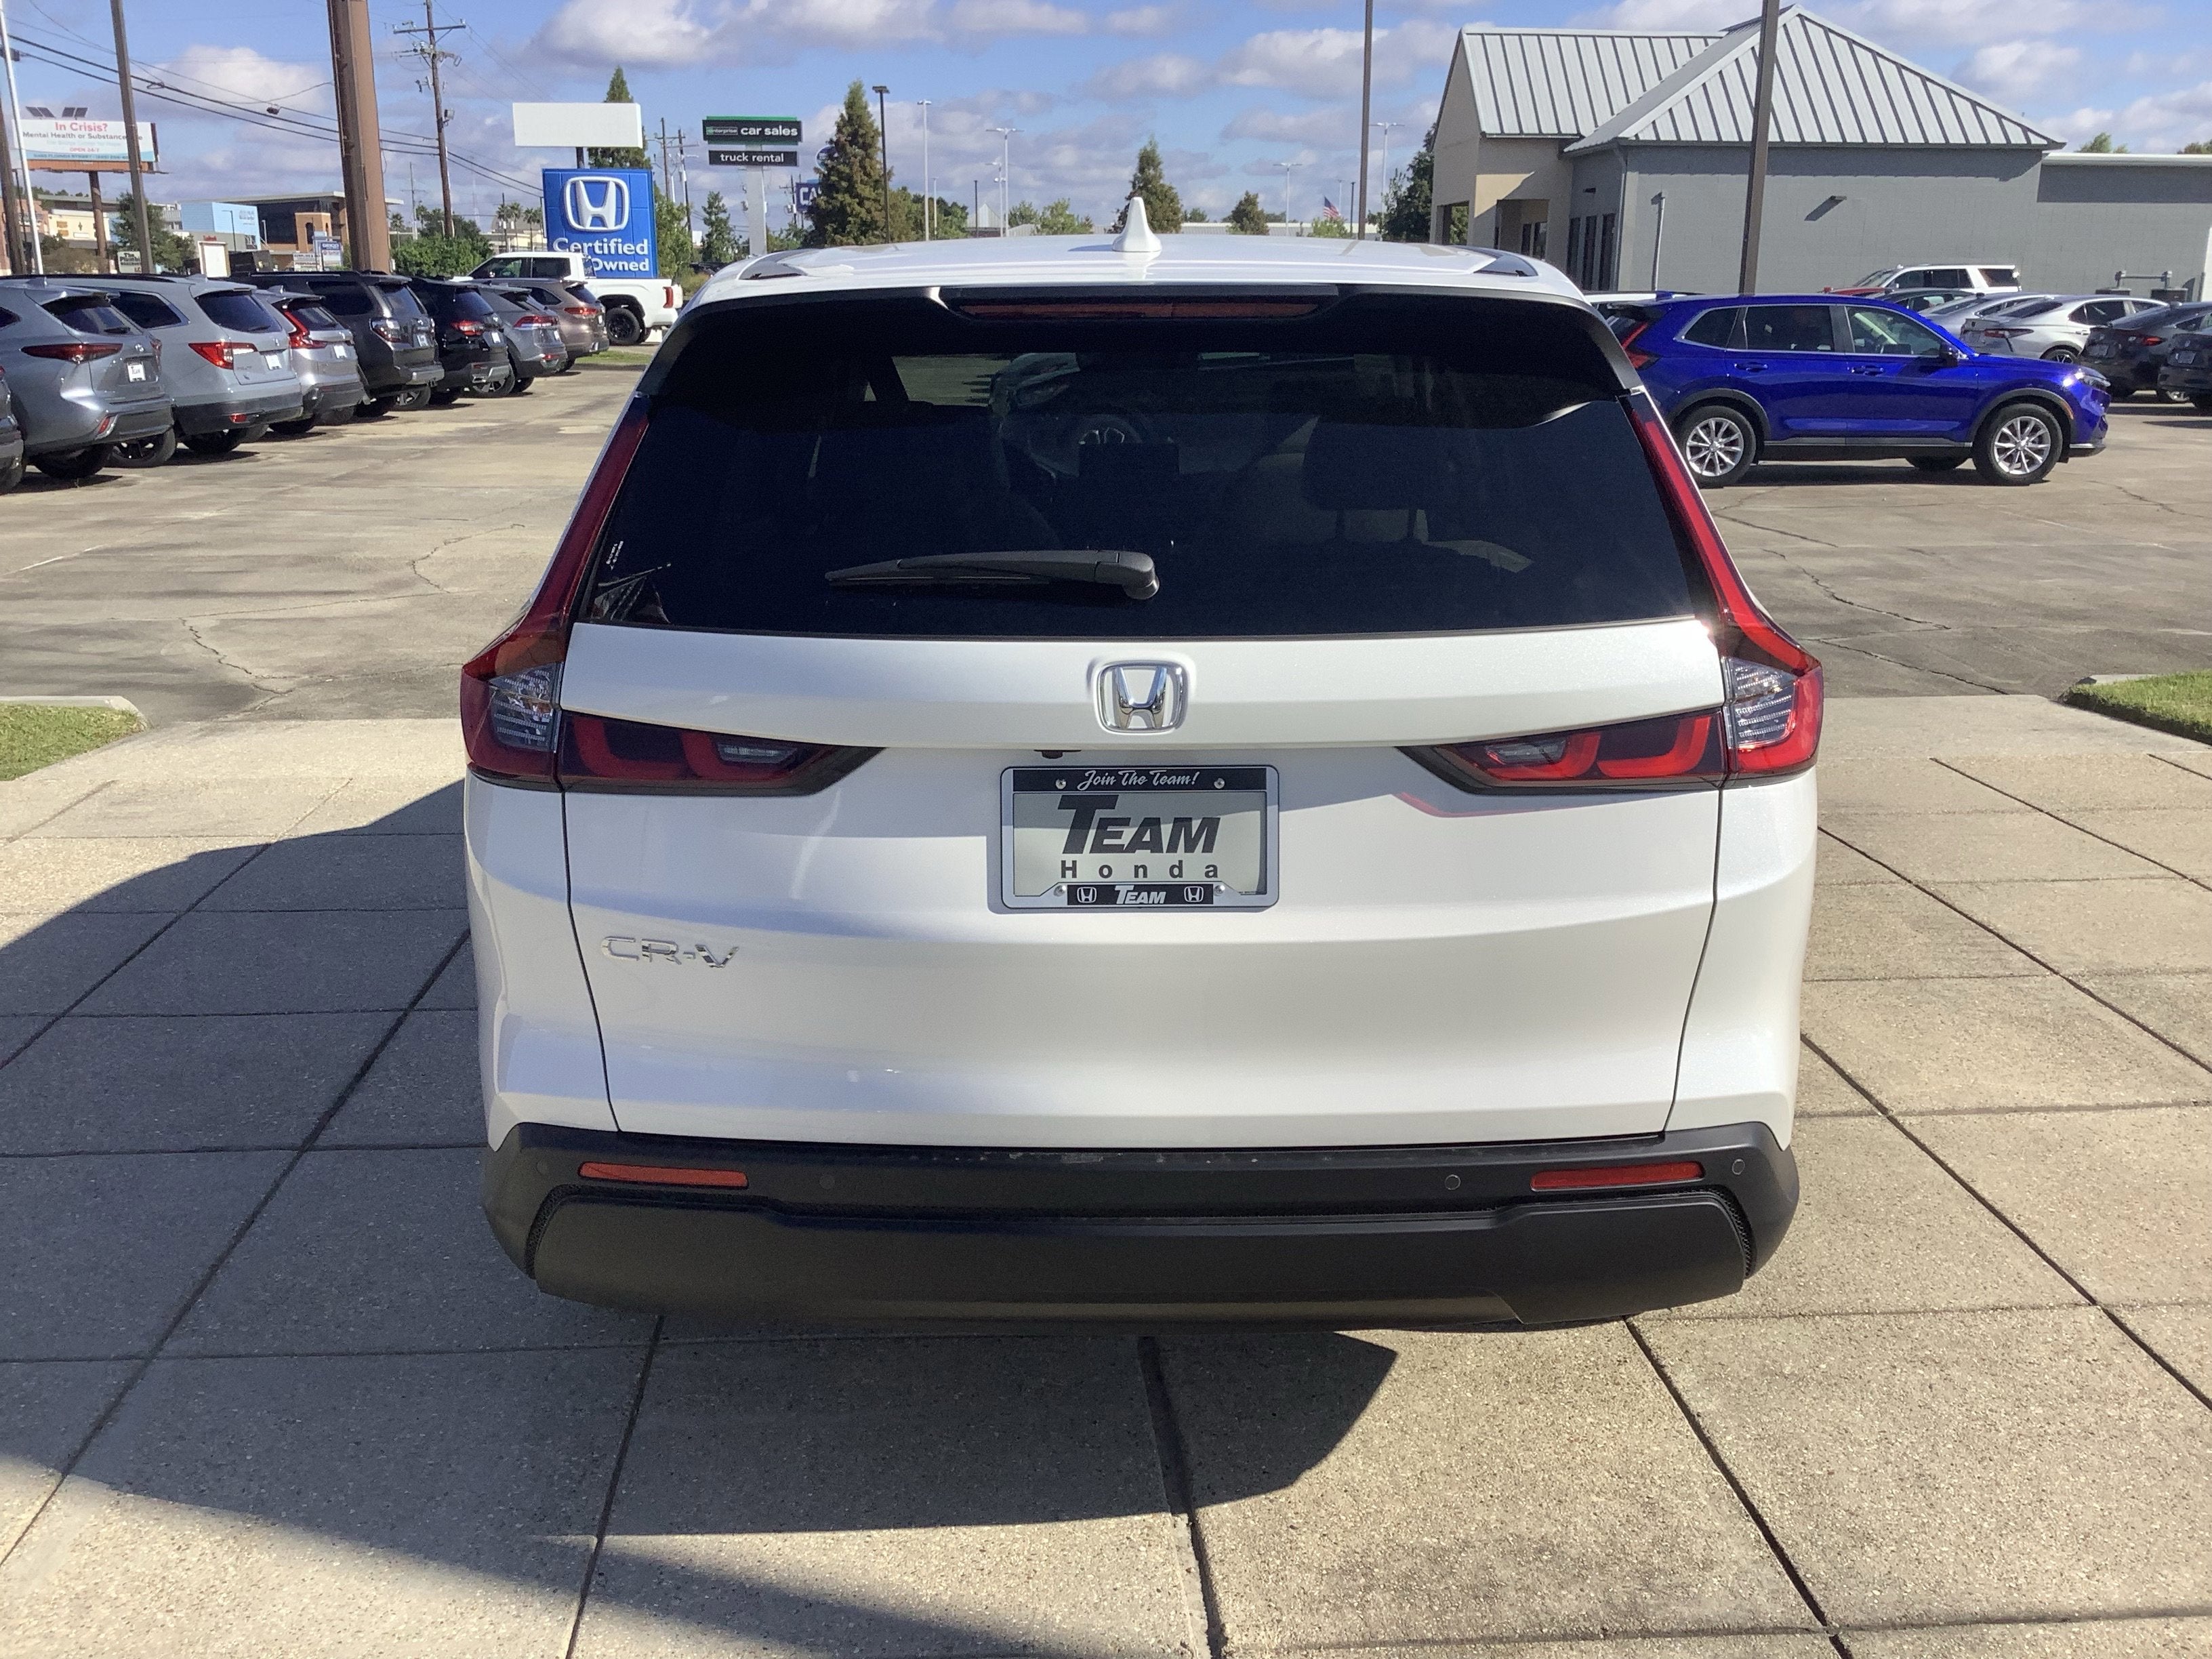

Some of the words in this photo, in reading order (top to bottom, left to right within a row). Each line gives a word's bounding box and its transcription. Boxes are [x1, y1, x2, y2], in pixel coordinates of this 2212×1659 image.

[55, 122, 66, 131] In
[70, 122, 108, 132] Crisis?
[741, 127, 762, 136] car
[764, 125, 798, 136] sales
[720, 152, 749, 163] truck
[752, 153, 784, 163] rental
[553, 238, 649, 255] Certified
[1077, 770, 1116, 791] Join
[1118, 770, 1148, 786] The
[1149, 770, 1200, 786] Team!
[1057, 794, 1221, 855] TEAM
[1061, 860, 1218, 879] Honda
[1115, 885, 1166, 905] TEAM
[601, 935, 740, 970] CR-V
